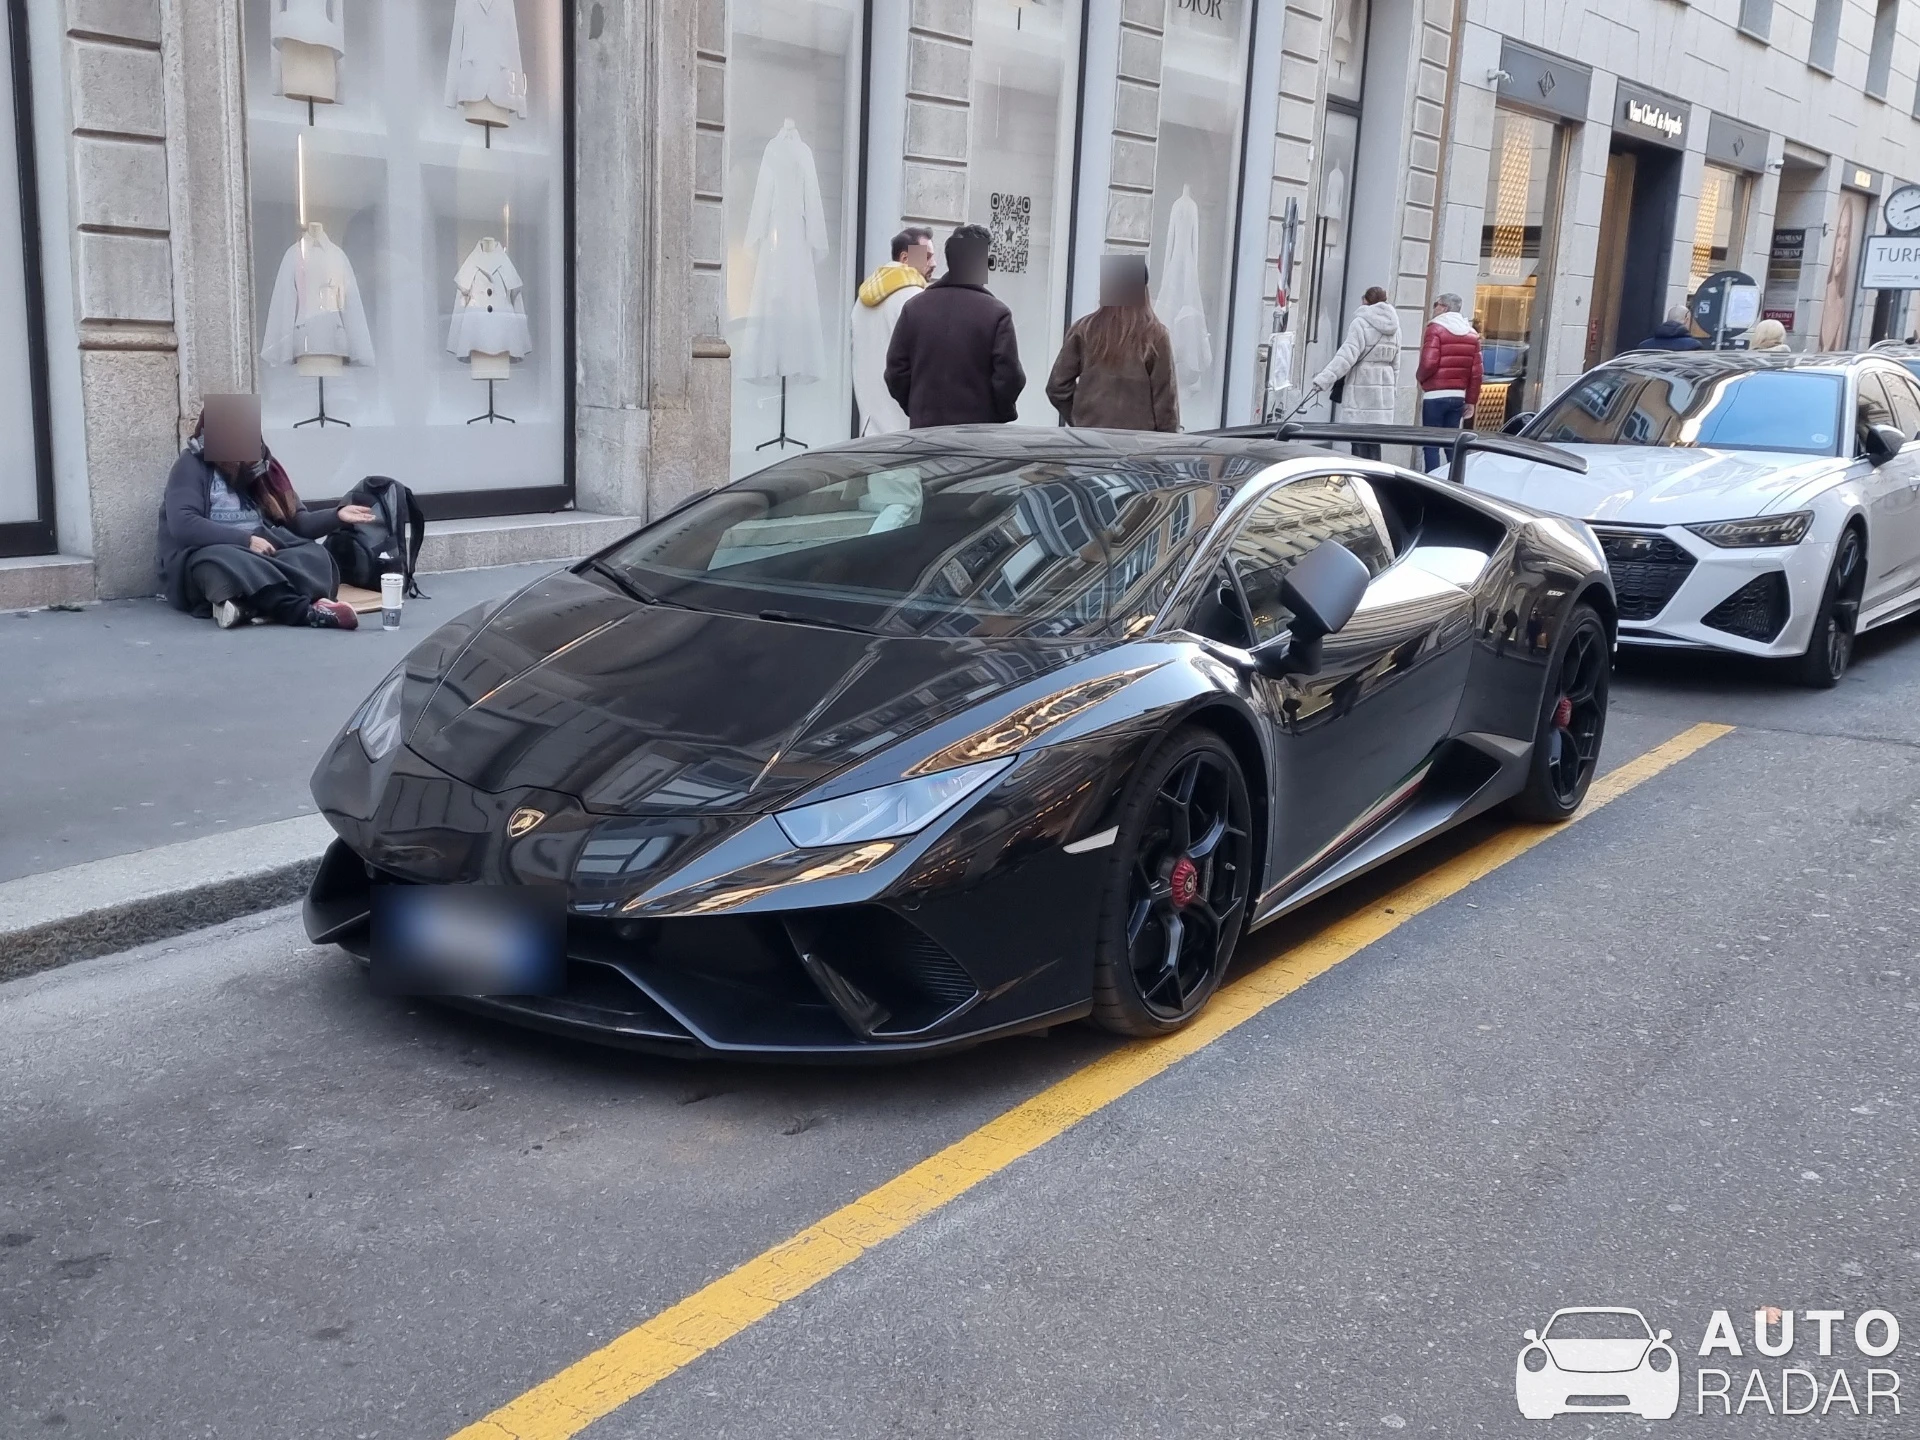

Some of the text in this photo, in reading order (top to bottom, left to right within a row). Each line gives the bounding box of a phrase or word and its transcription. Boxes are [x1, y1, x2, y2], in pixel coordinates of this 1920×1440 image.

[1629, 99, 1642, 123] Van
[1642, 103, 1660, 128] Cleef
[1662, 111, 1683, 139] Arpels
